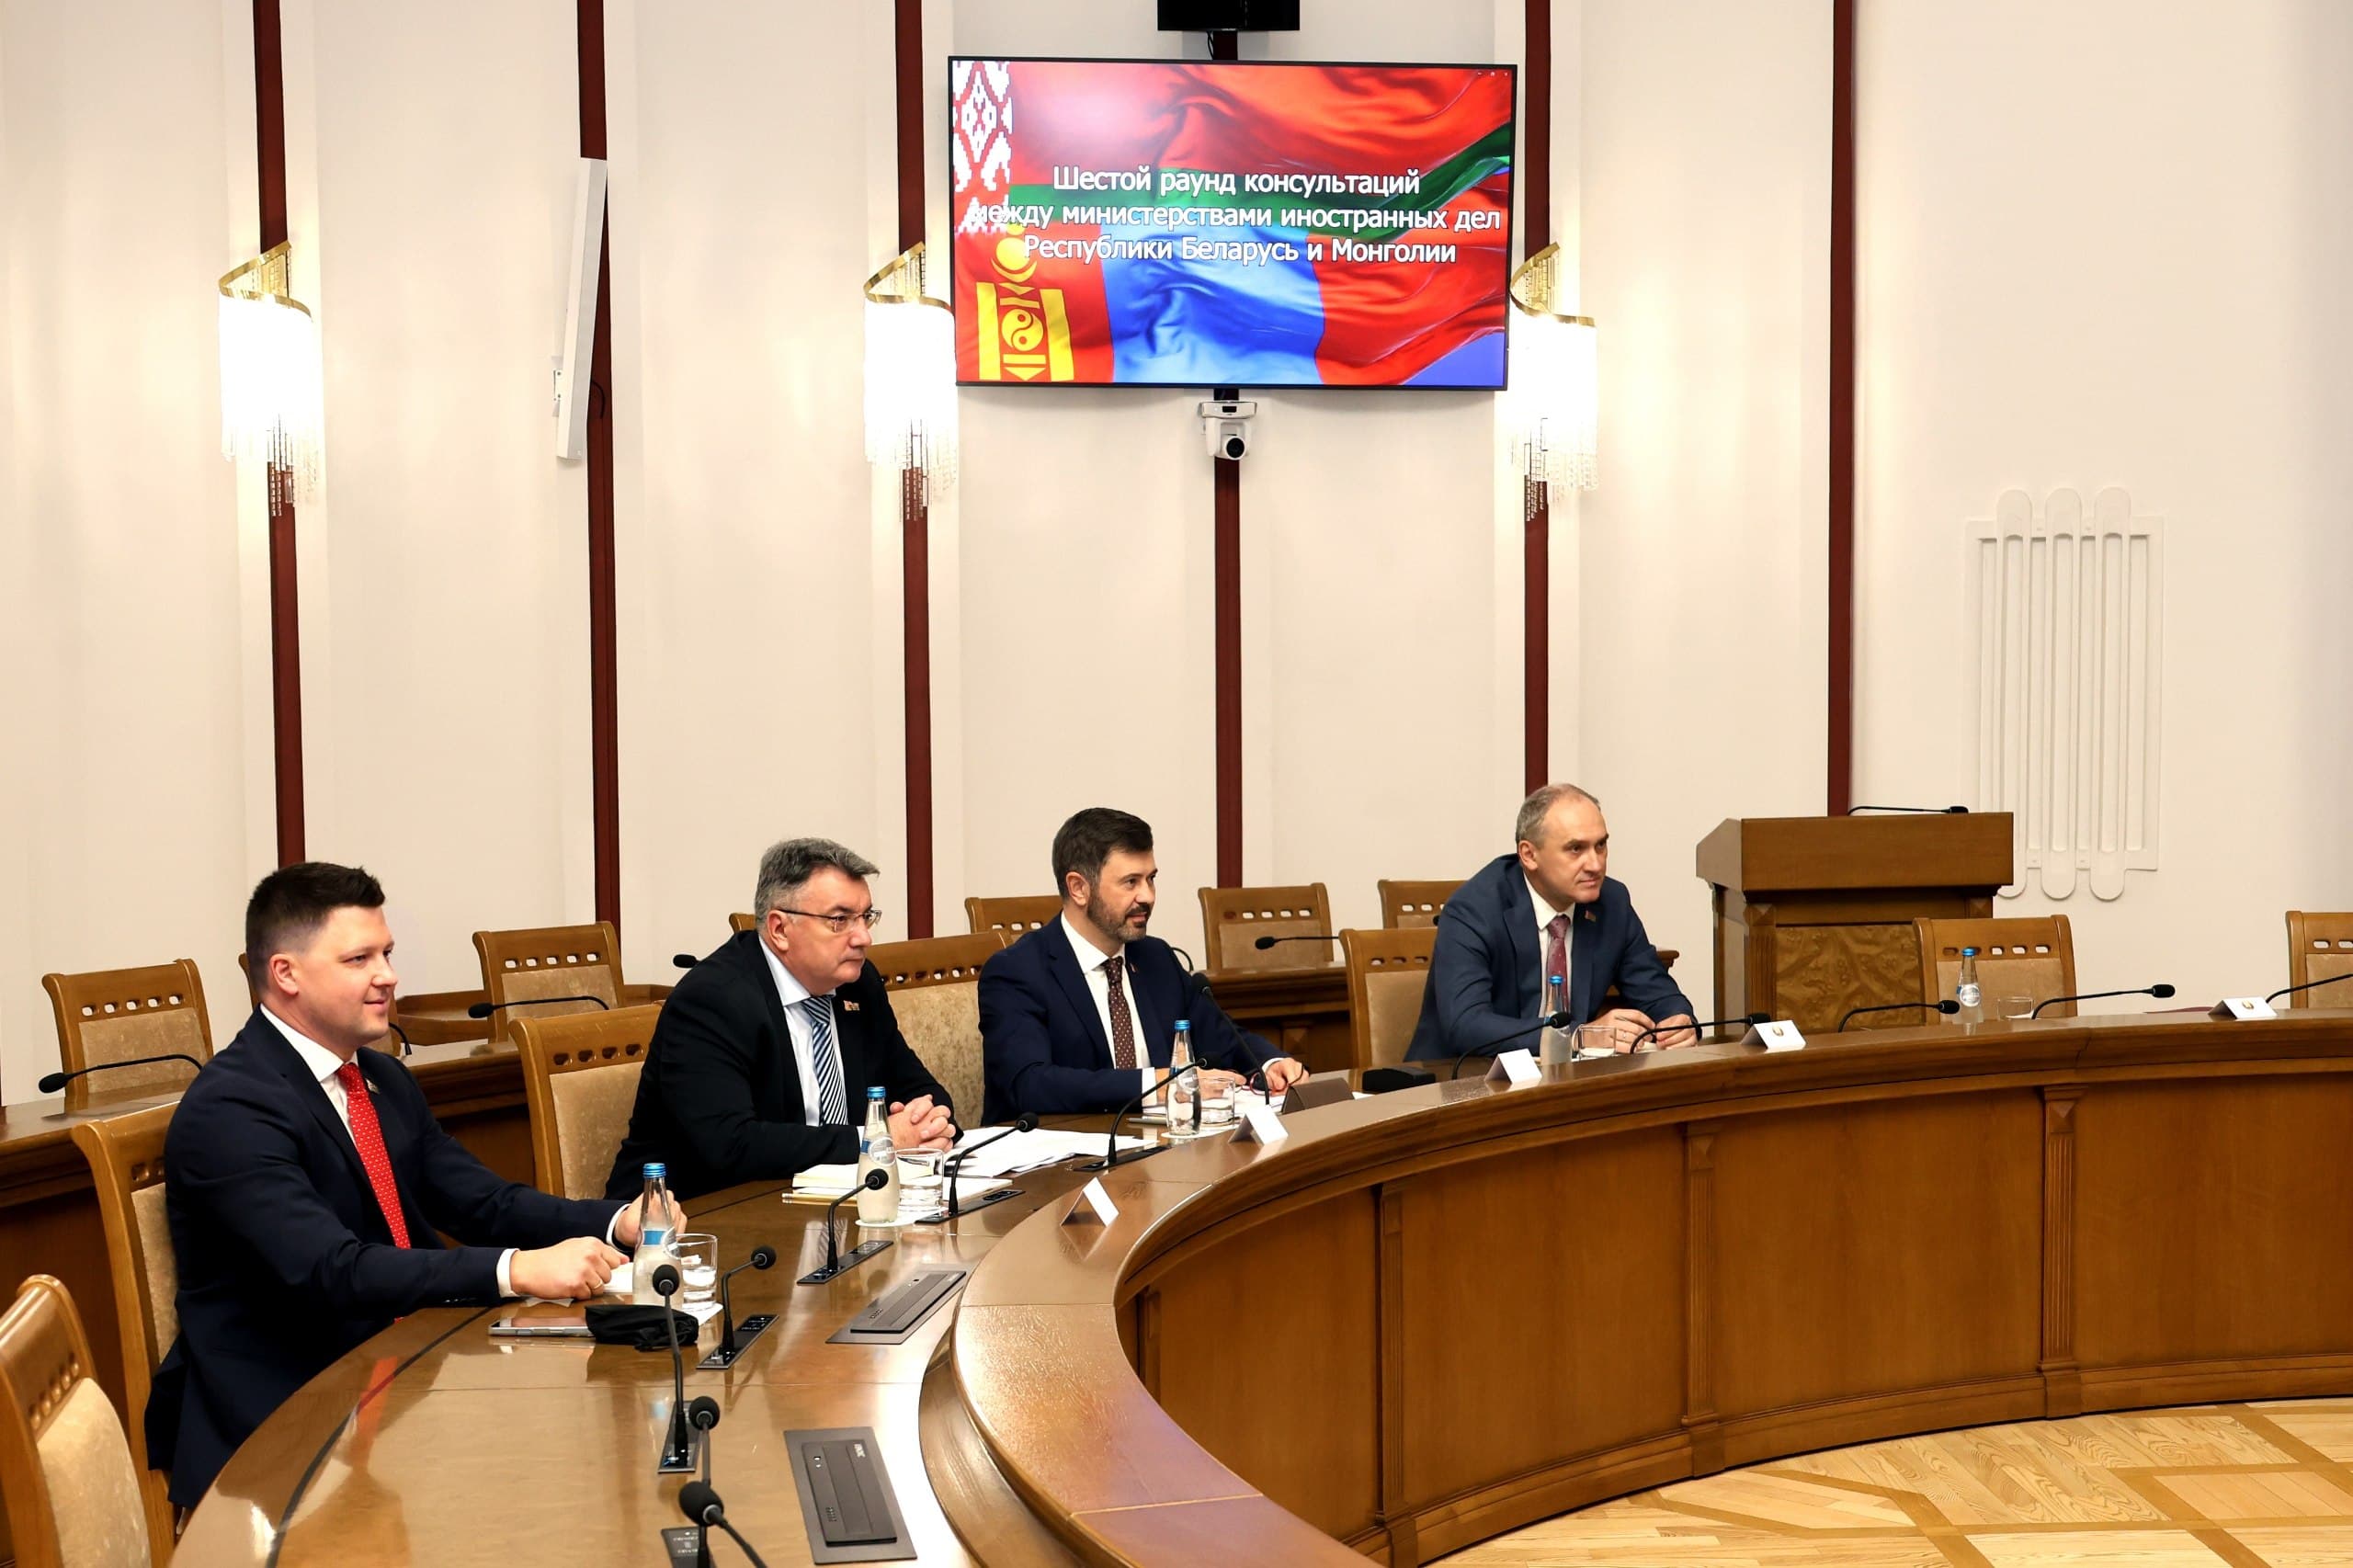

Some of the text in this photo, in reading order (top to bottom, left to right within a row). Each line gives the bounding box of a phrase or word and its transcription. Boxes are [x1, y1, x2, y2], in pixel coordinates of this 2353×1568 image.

[1054, 165, 1420, 199] Шестой раунд консультаций
[1063, 205, 1272, 231] министерствами
[1281, 209, 1448, 233] иностранных
[1454, 210, 1500, 232] дел
[1024, 234, 1456, 267] Республики Беларусь и Монголии
